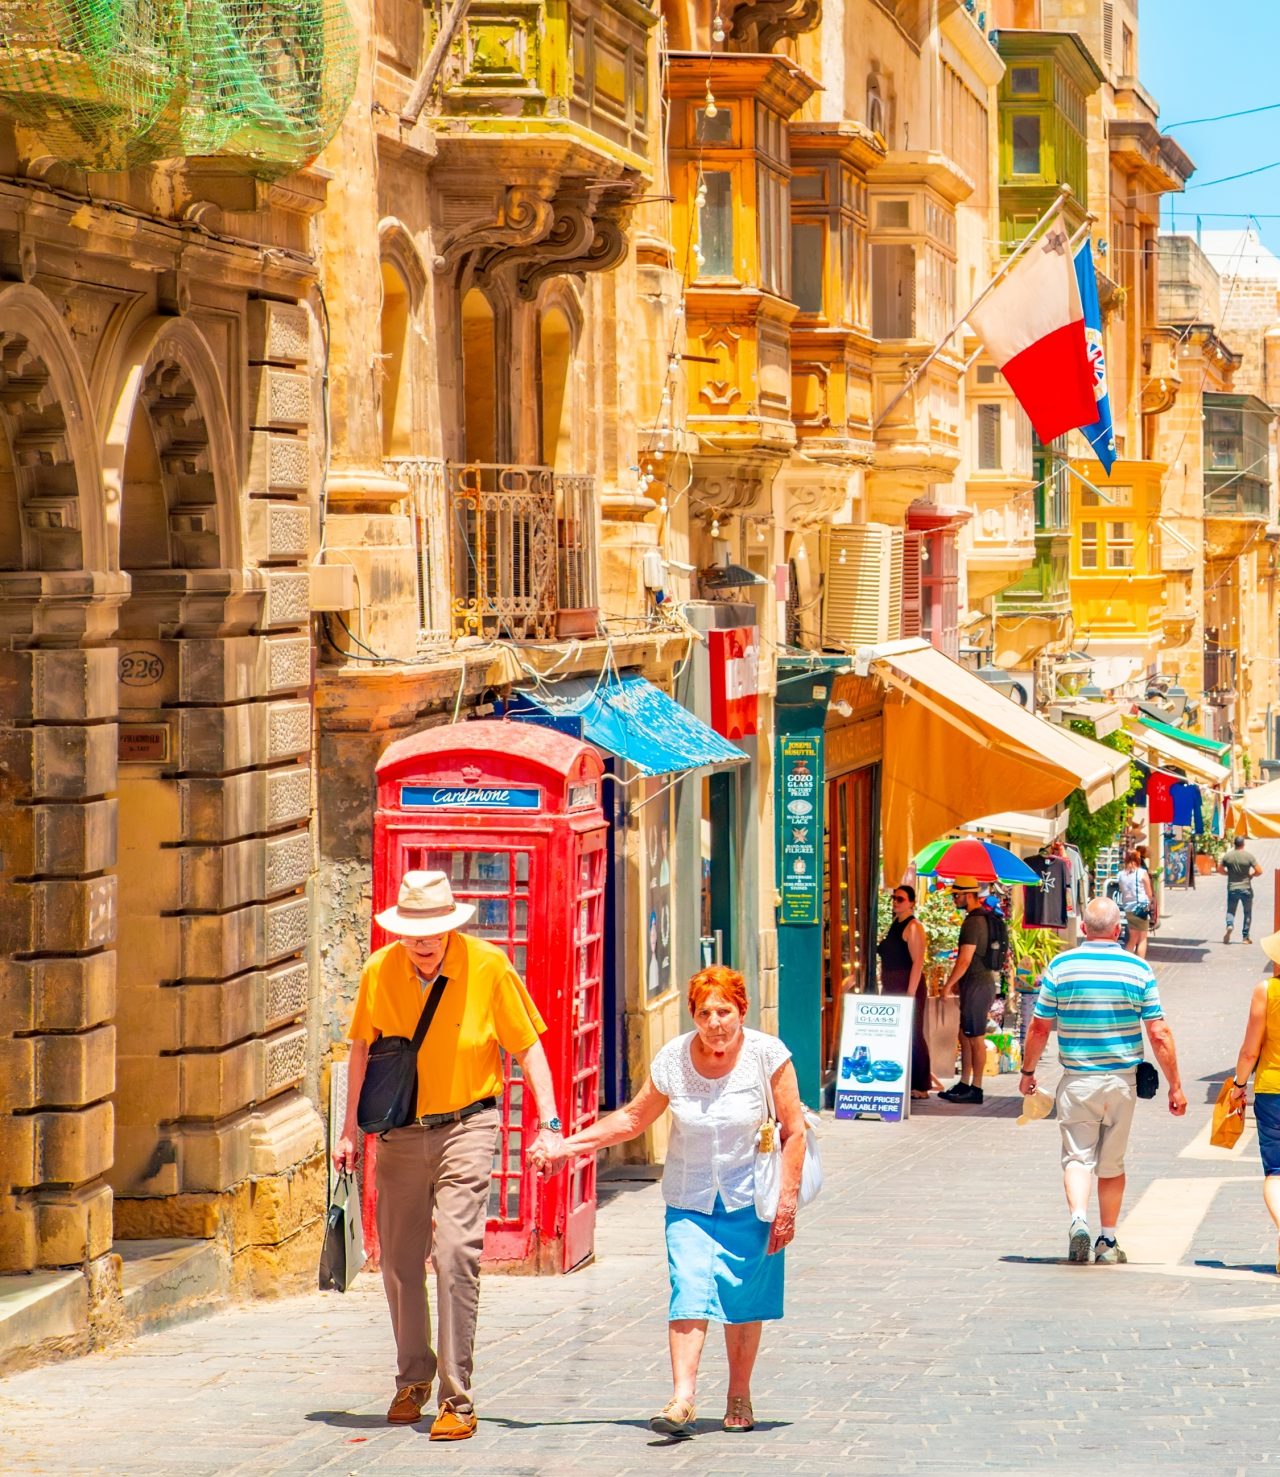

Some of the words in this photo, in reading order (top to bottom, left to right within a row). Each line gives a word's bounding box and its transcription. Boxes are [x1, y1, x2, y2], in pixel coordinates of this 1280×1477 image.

[121, 658, 160, 678] 226
[787, 774, 813, 782] GOZO
[432, 788, 510, 806] Cardphone
[860, 1005, 895, 1016] GOZO
[839, 1094, 872, 1102] FACTORY
[873, 1096, 900, 1104] PRICES
[840, 1103, 877, 1111] AVAILABLE
[878, 1104, 899, 1112] HERE
